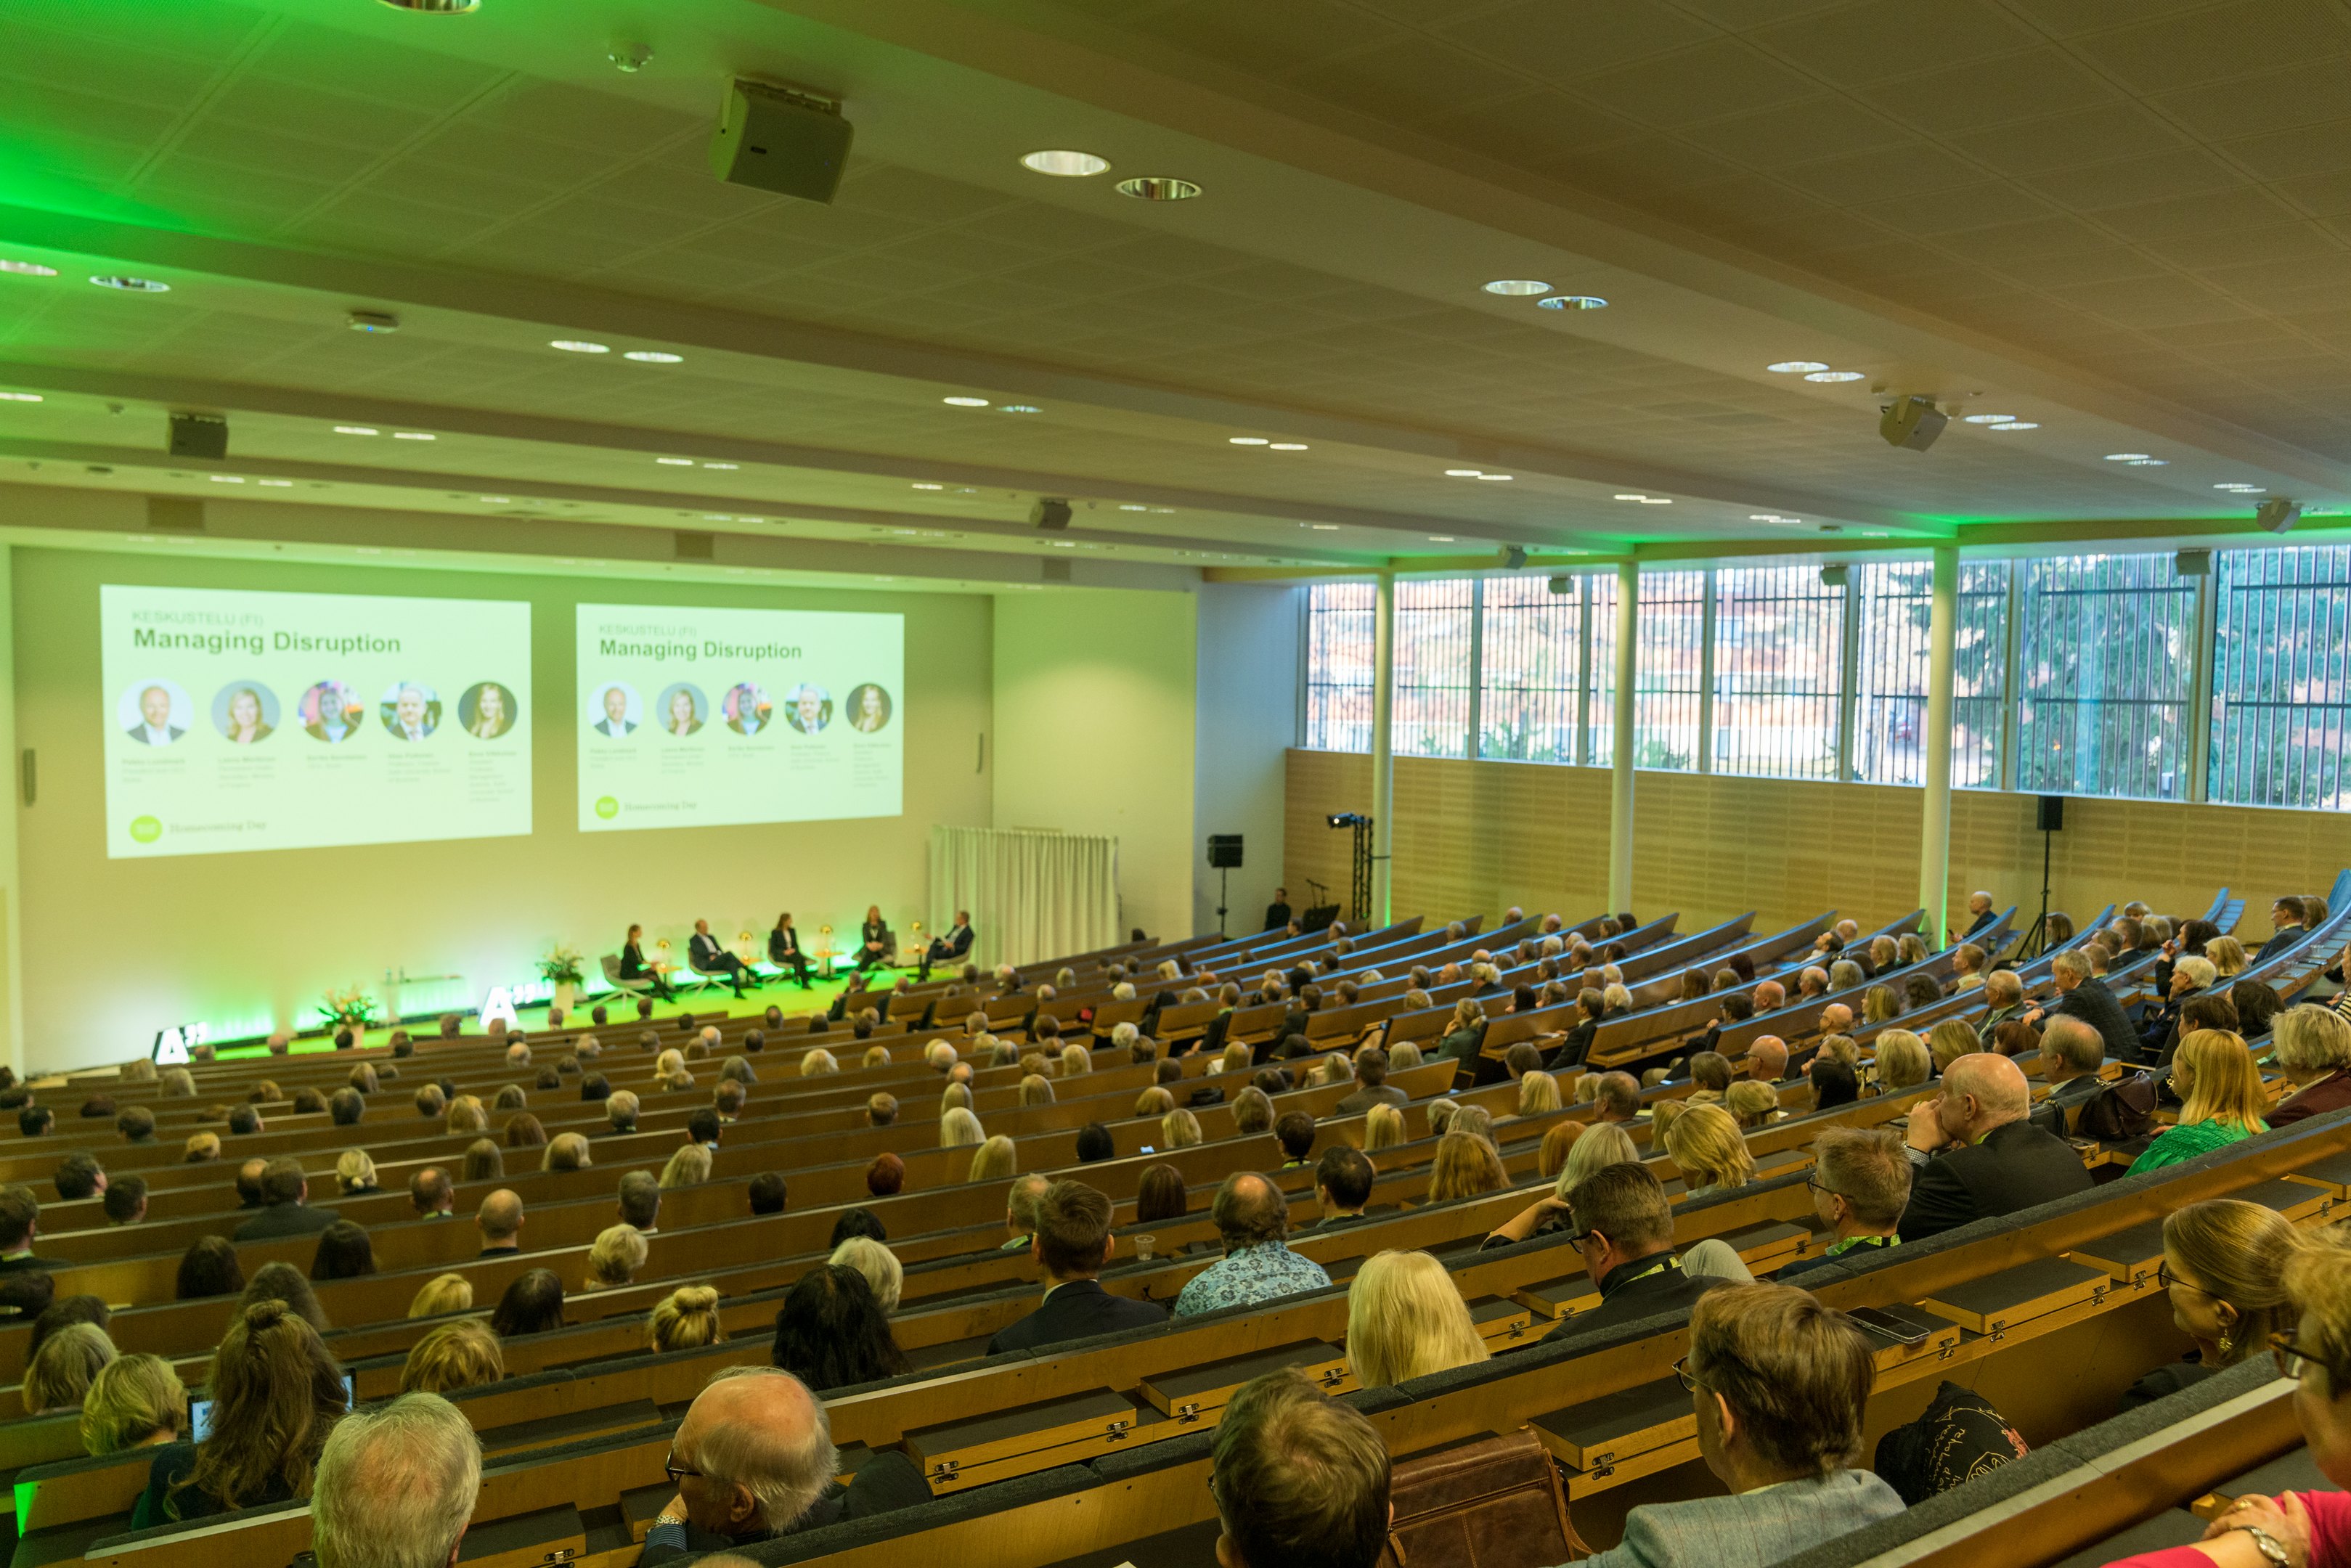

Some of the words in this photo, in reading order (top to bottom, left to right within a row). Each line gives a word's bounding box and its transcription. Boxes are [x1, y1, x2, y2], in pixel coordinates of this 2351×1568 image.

[132, 611, 237, 626] KESKUSTELU
[599, 625, 676, 637] KESKUSTELU
[134, 629, 264, 656] Managing
[274, 631, 402, 656] Disruption
[600, 640, 696, 661] Managing
[704, 641, 802, 661] Disruption
